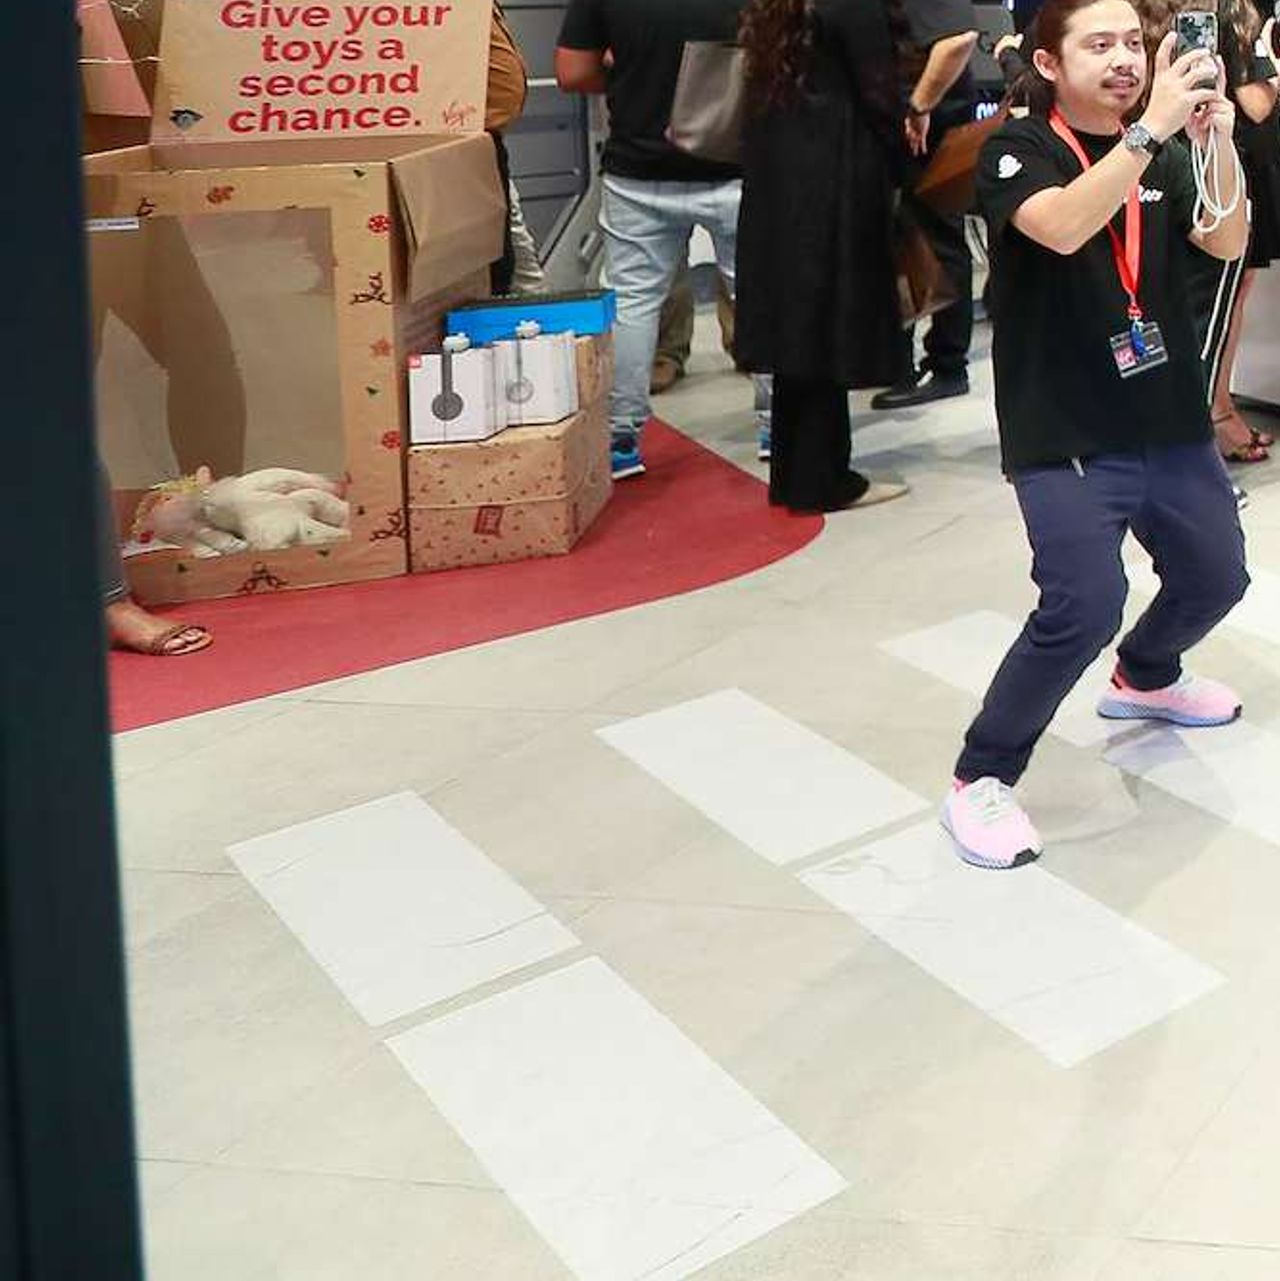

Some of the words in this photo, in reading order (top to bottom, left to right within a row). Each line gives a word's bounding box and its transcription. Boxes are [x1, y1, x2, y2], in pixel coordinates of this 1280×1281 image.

[220, 0, 331, 29] Give
[344, 1, 453, 35] your
[260, 33, 364, 69] toys
[377, 36, 404, 60] a
[239, 65, 420, 98] second
[228, 102, 422, 133] chance.
